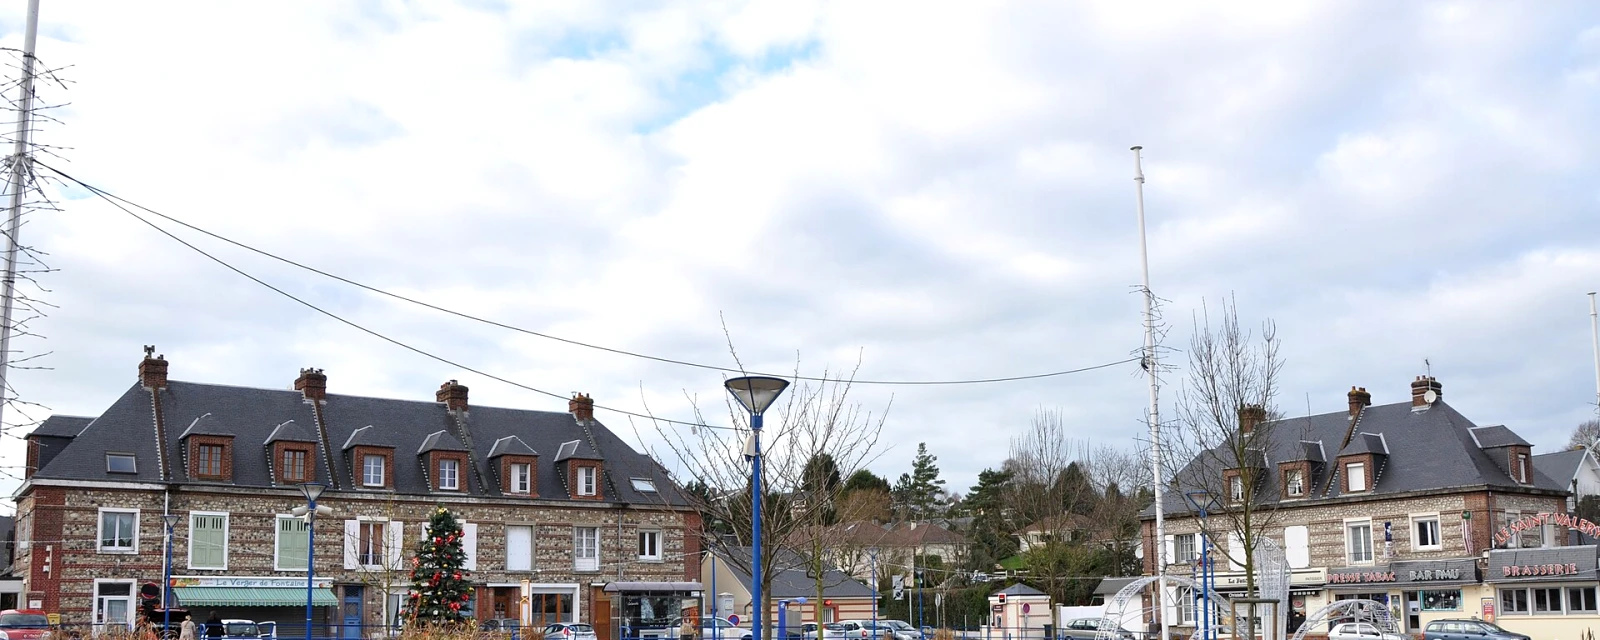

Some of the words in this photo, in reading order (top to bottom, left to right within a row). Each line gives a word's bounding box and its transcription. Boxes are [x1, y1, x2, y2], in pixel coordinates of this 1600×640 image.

[1495, 527, 1511, 545] LE
[1510, 512, 1550, 532] SAINT
[1553, 512, 1600, 539] VALERY
[1409, 570, 1432, 581] BAR
[1435, 569, 1460, 580] PMU
[1503, 563, 1577, 576] BRASSERIE
[216, 578, 227, 586] Le
[230, 578, 258, 587] Verger
[271, 579, 305, 587] Fontaine
[1327, 572, 1361, 584] PRESSE
[1363, 571, 1396, 582] TABAC
